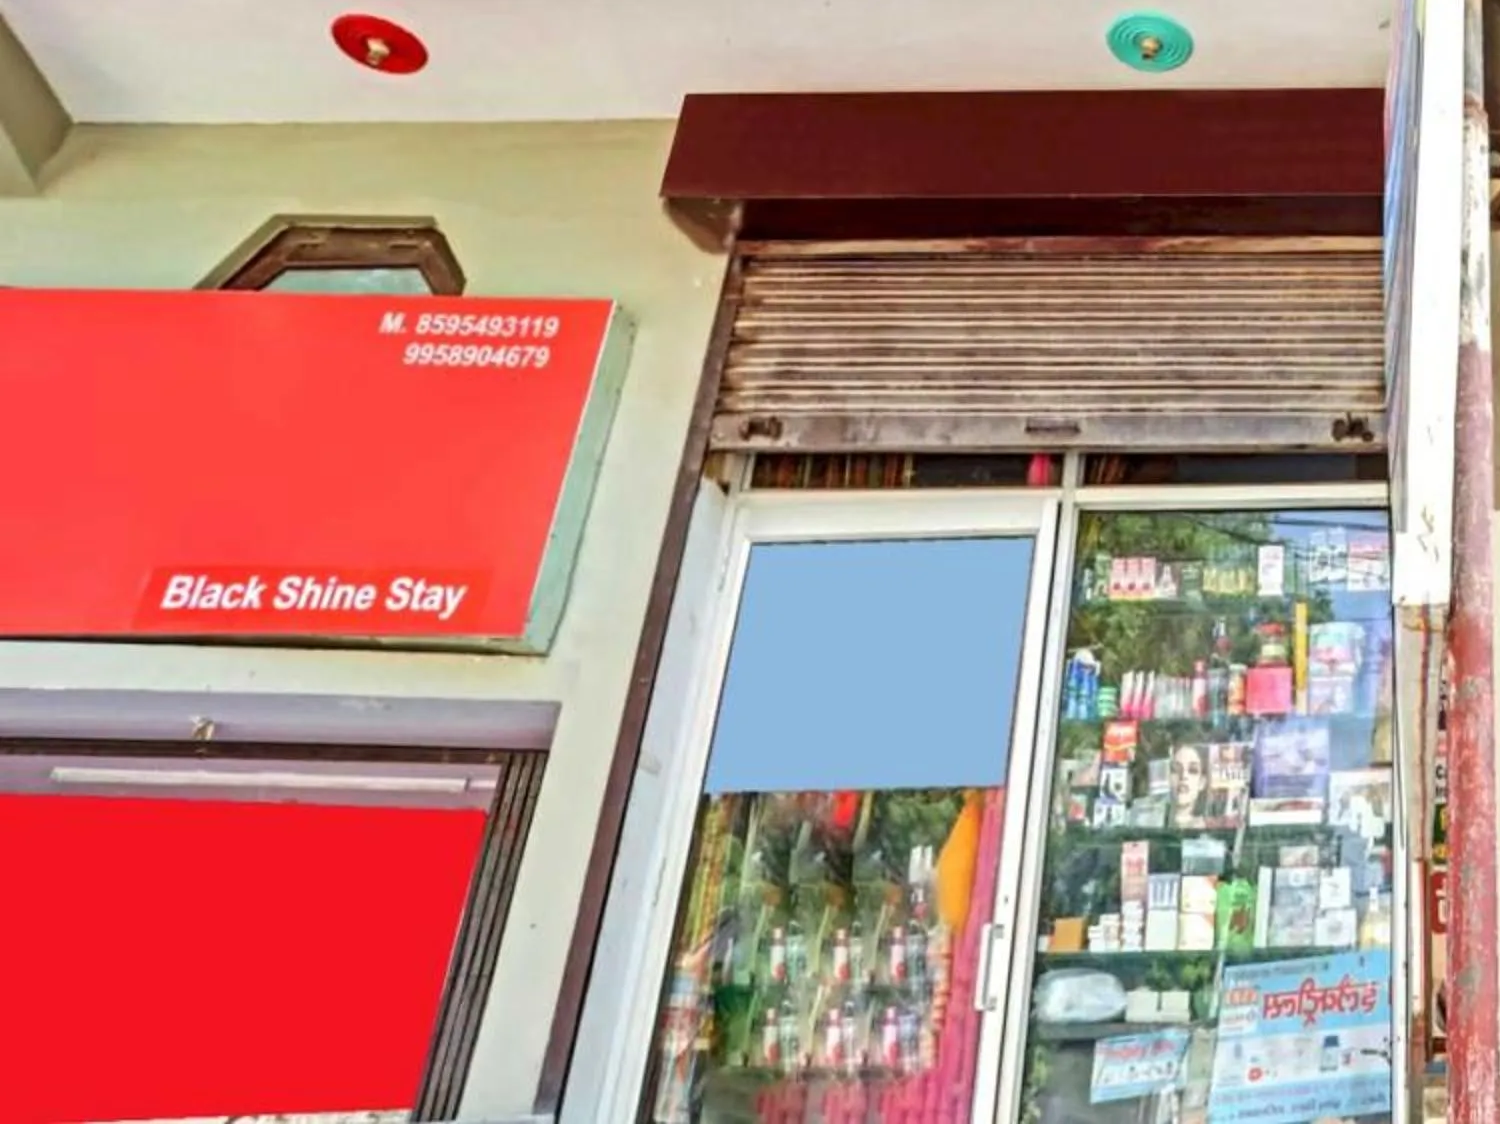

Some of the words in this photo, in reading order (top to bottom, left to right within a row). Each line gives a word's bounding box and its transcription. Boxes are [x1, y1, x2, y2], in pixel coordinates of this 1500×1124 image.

[379, 312, 407, 334] M.
[415, 313, 560, 338] 8595493119
[403, 341, 550, 368] 9958904679
[160, 575, 267, 609] Black
[272, 576, 377, 611] Shine
[385, 577, 467, 620] Stay
